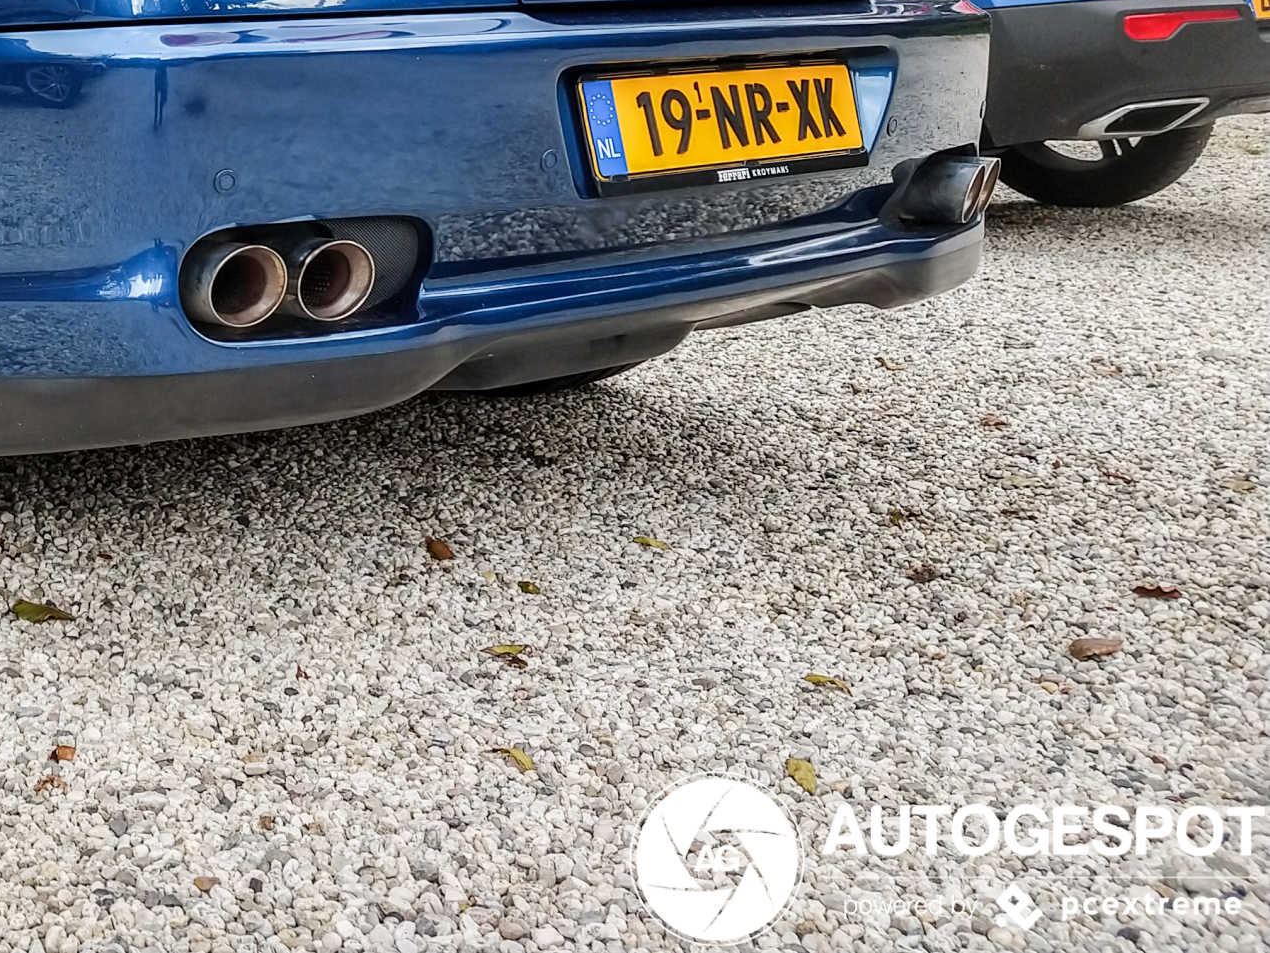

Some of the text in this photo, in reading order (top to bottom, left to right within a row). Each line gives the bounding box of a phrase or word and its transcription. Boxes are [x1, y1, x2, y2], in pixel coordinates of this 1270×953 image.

[636, 78, 847, 157] 19-NR-XK
[596, 138, 622, 160] NL
[717, 165, 790, 183] Ferrari KROYMANS
